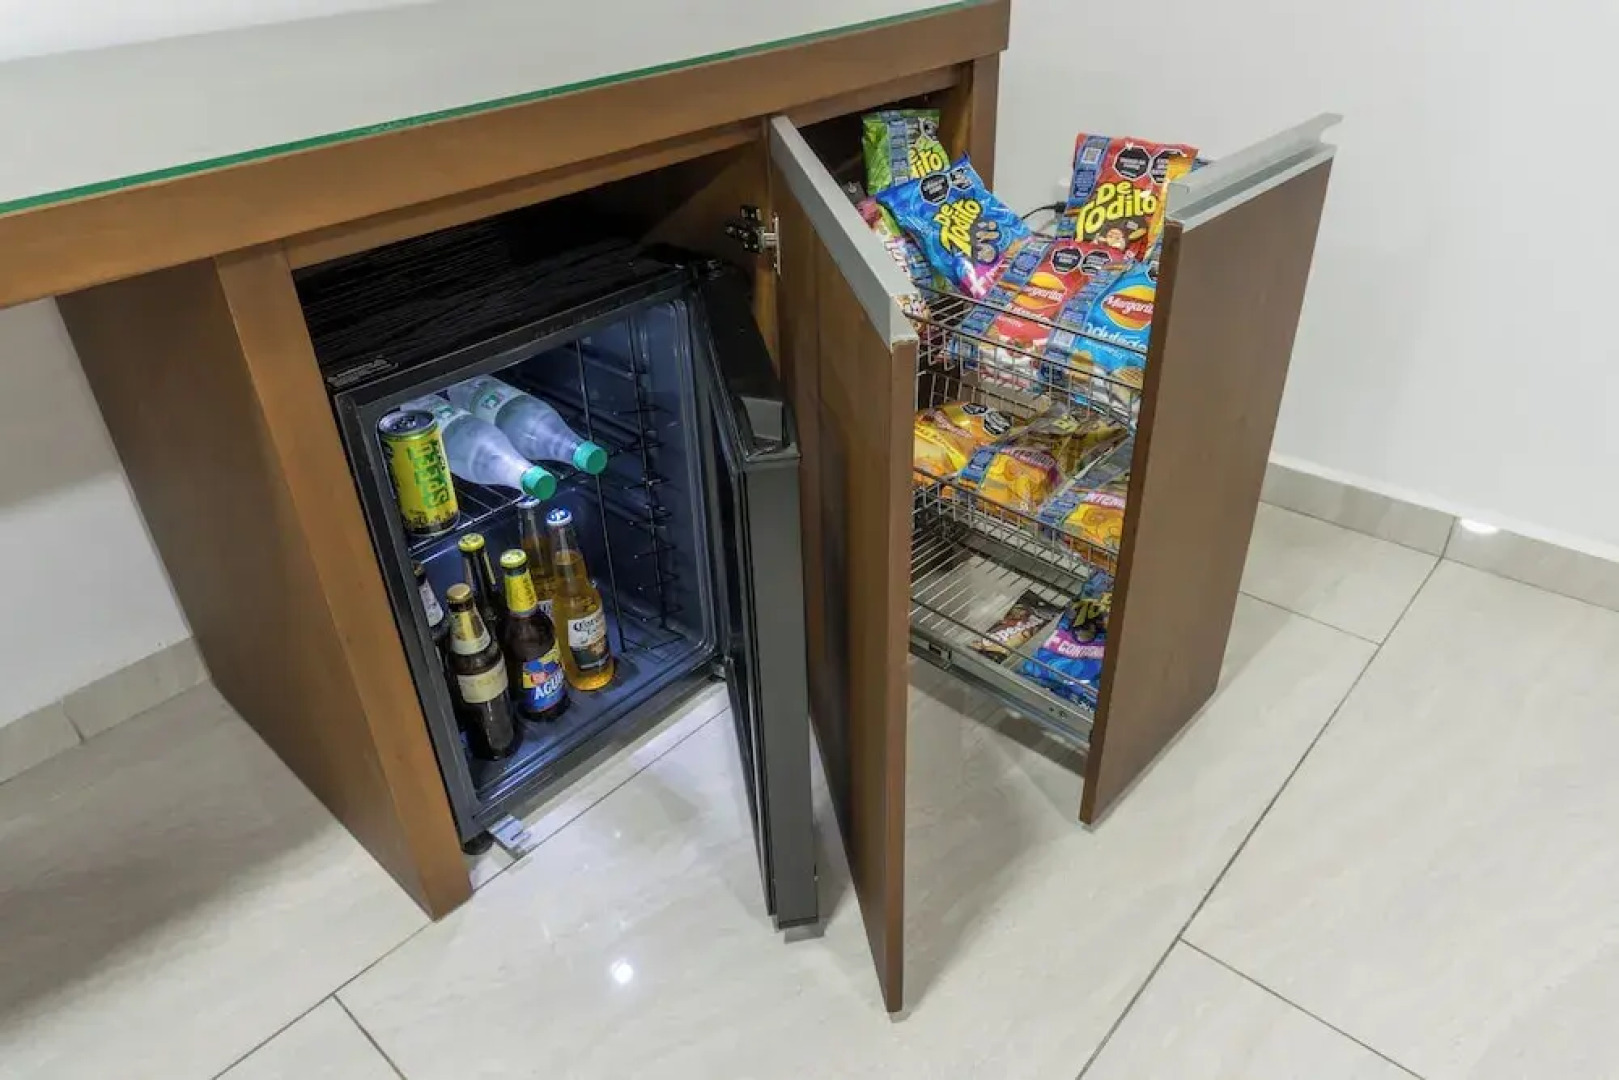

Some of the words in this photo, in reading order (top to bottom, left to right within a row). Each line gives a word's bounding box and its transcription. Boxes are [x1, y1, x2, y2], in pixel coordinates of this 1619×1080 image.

[1096, 181, 1133, 205] De
[933, 203, 953, 228] De
[941, 199, 981, 258] Todito
[1076, 188, 1158, 241] Todito
